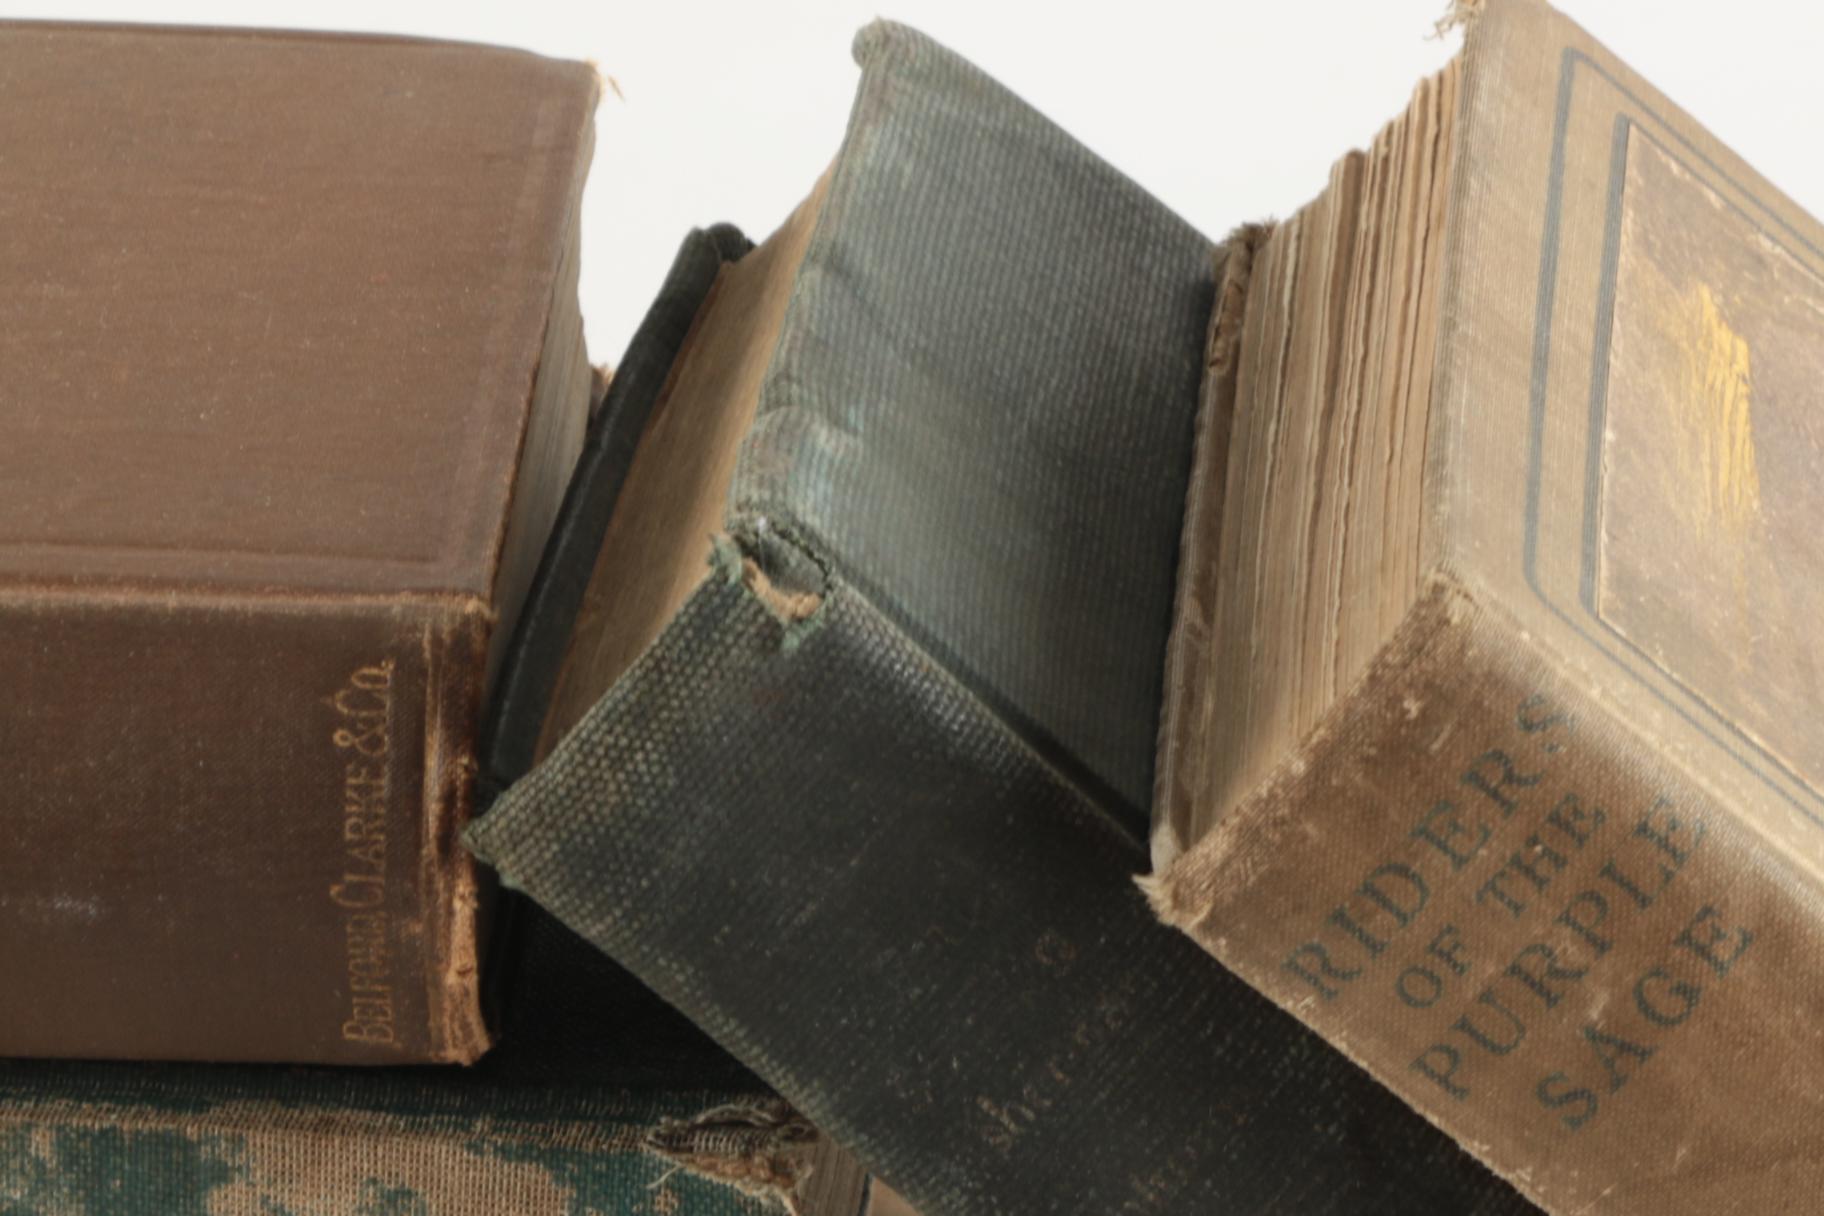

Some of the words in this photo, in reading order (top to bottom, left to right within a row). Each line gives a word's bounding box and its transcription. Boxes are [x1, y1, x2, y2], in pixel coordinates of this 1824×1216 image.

[1281, 694, 1575, 1001] RIDERS
[1395, 924, 1474, 1009] OF
[1477, 792, 1608, 918] THE
[1411, 795, 1708, 1101] PURPLE
[1536, 906, 1754, 1130] SAGE
